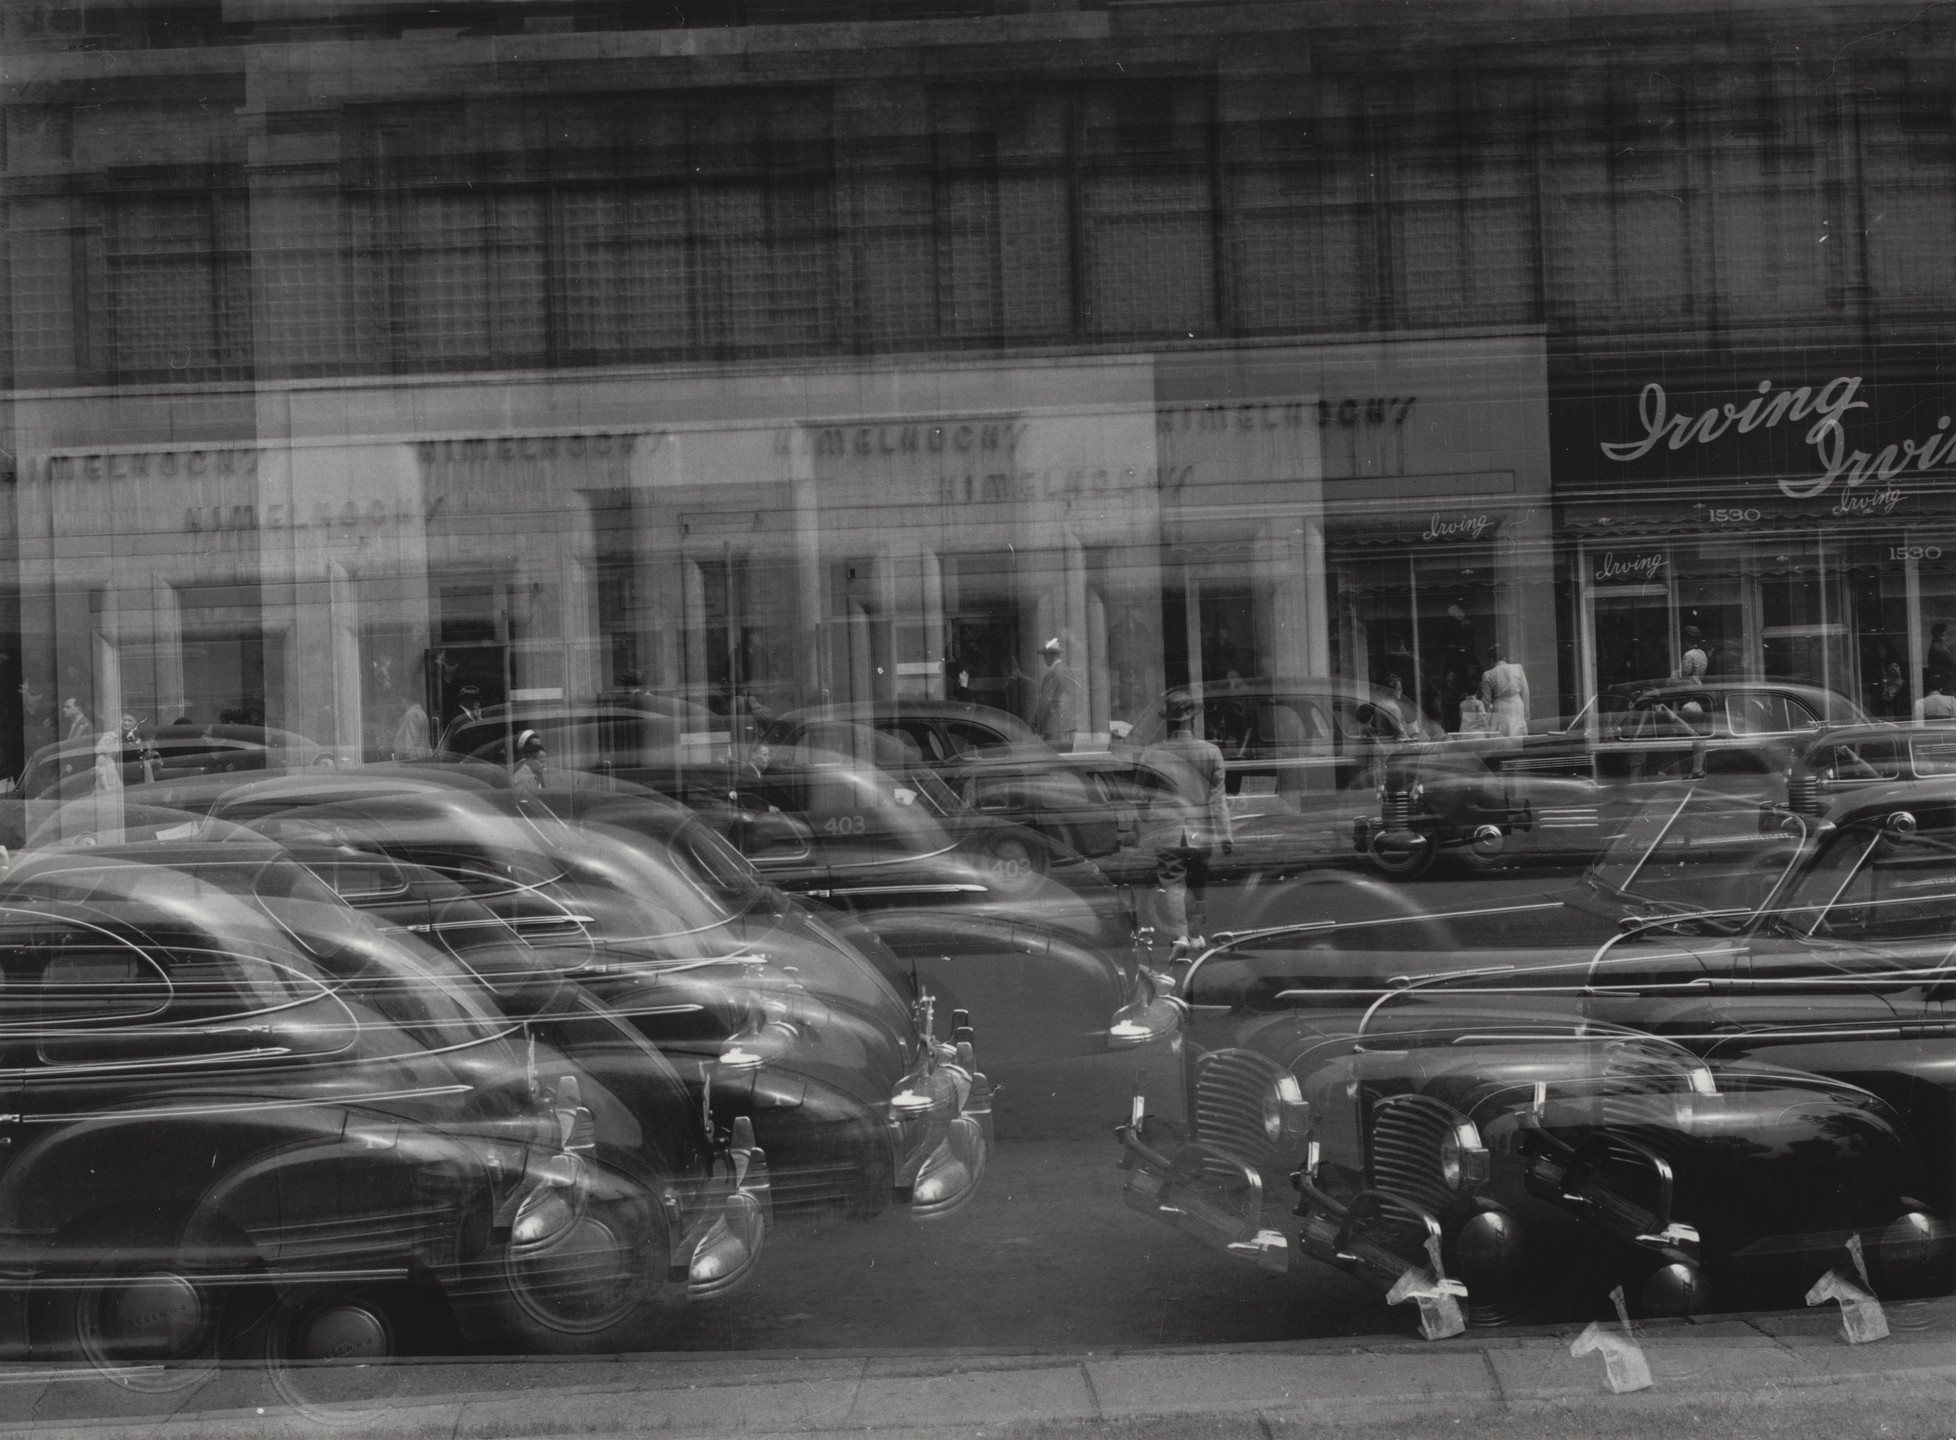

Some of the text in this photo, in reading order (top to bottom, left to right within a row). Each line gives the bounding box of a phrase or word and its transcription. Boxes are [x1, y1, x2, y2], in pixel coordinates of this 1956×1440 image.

[1600, 375, 1870, 462] Irving
[1832, 485, 1908, 515] Irving
[1423, 512, 1495, 540] Irving
[1708, 508, 1762, 522] 1530
[1595, 552, 1670, 580] Irving
[1889, 546, 1942, 560] 1530
[823, 815, 866, 834] 403
